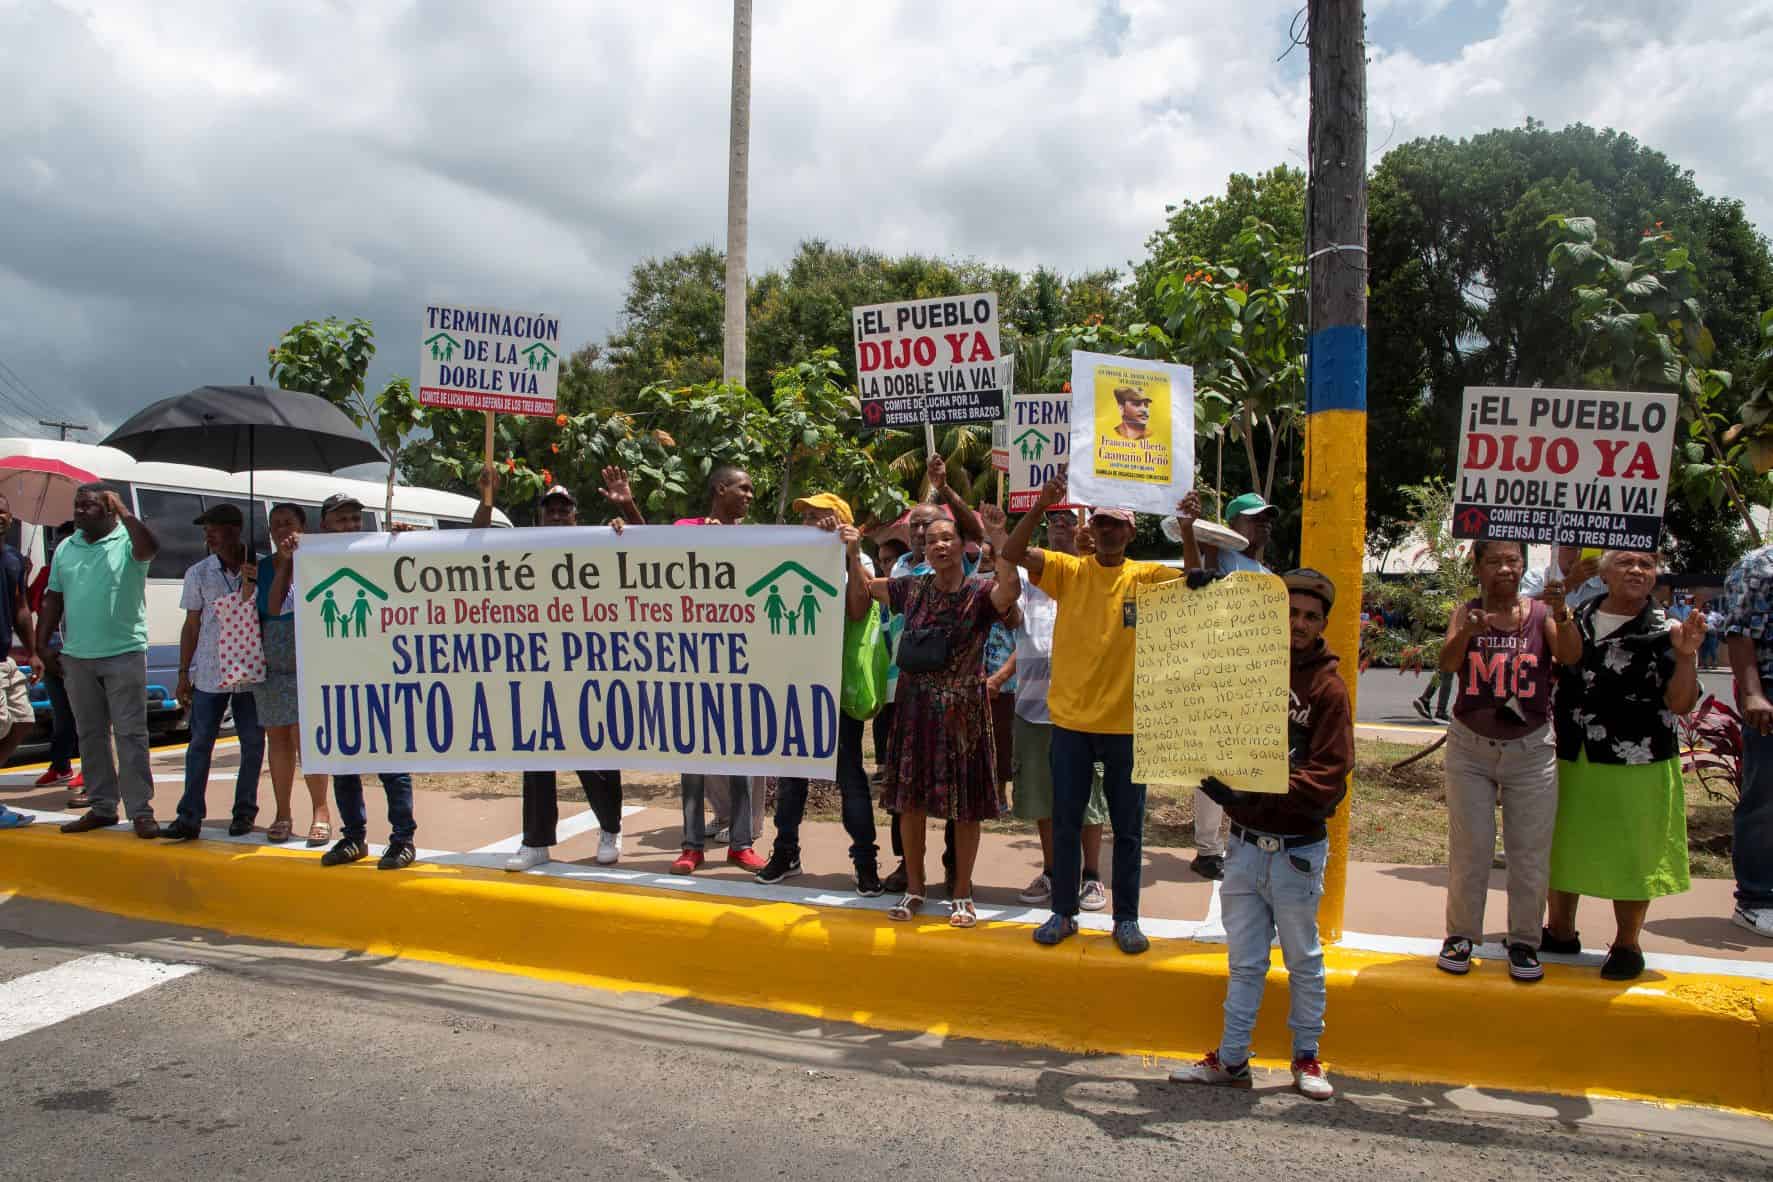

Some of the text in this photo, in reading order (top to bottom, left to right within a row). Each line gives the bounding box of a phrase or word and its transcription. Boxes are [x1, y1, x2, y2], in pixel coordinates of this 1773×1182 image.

[427, 306, 558, 341] TERMINACIÓN
[857, 299, 990, 341] ¡EL PUEBLO
[464, 339, 517, 365] DE LA
[858, 331, 994, 371] DIJO YA
[440, 365, 538, 394] DOBLE VÍA
[861, 377, 880, 398] LA
[884, 371, 934, 396] DOBLE
[938, 366, 966, 392] VÍA
[970, 367, 996, 389] VA!
[886, 412, 918, 424] DEFENSA
[931, 409, 945, 421] LOS
[947, 408, 967, 420] TRES
[969, 406, 1000, 418] BRAZOS
[913, 397, 924, 408] DE
[925, 396, 950, 408] LUCHA
[952, 395, 968, 406] POR
[969, 394, 980, 405] LA
[1015, 400, 1071, 424] TERM
[1469, 396, 1666, 433] ¡EL PUEBLO
[1463, 433, 1660, 480] DIJO YA
[1461, 476, 1657, 514] LA DOBLE VÍA VA!
[1488, 525, 1653, 548] DEFENSA DE LOS TRES BRAZOS
[1532, 511, 1546, 524] DE
[1549, 511, 1584, 528] LUCHA
[1587, 515, 1609, 529] POR
[1612, 516, 1626, 530] LA
[393, 551, 736, 593] Comité de Lucha
[381, 595, 755, 632] por la Defensa de Los Tres Brazos
[392, 631, 749, 674] SIEMPRE PRESENTE
[1466, 651, 1537, 698] ME
[315, 679, 837, 758] JUNTO A LA COMUNIDAD
